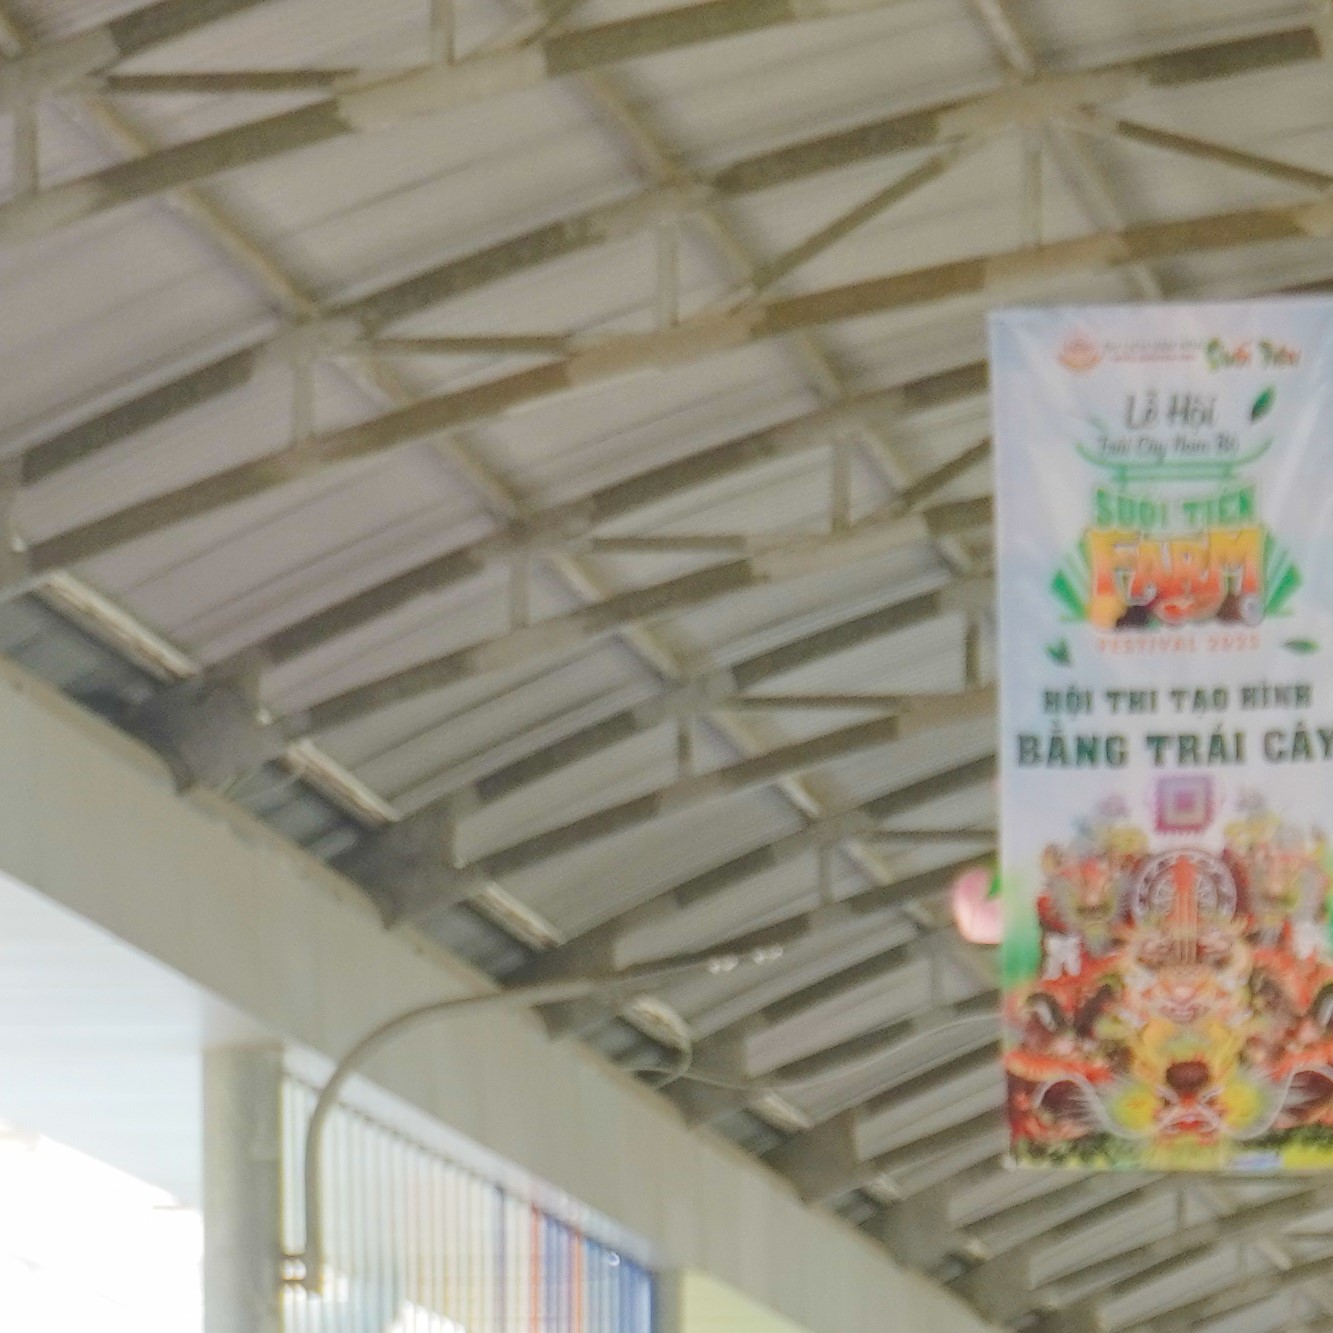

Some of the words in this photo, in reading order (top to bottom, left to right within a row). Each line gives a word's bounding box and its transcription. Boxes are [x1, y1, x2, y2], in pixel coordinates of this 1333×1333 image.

[1087, 528, 1265, 605] FARM
[1043, 682, 1094, 718] HỘI
[1106, 688, 1159, 714] THI
[1169, 687, 1229, 718] TẠO
[1240, 680, 1314, 711] HÌNH
[1016, 719, 1128, 769] BẰNG
[1144, 722, 1246, 768] TRÁI
